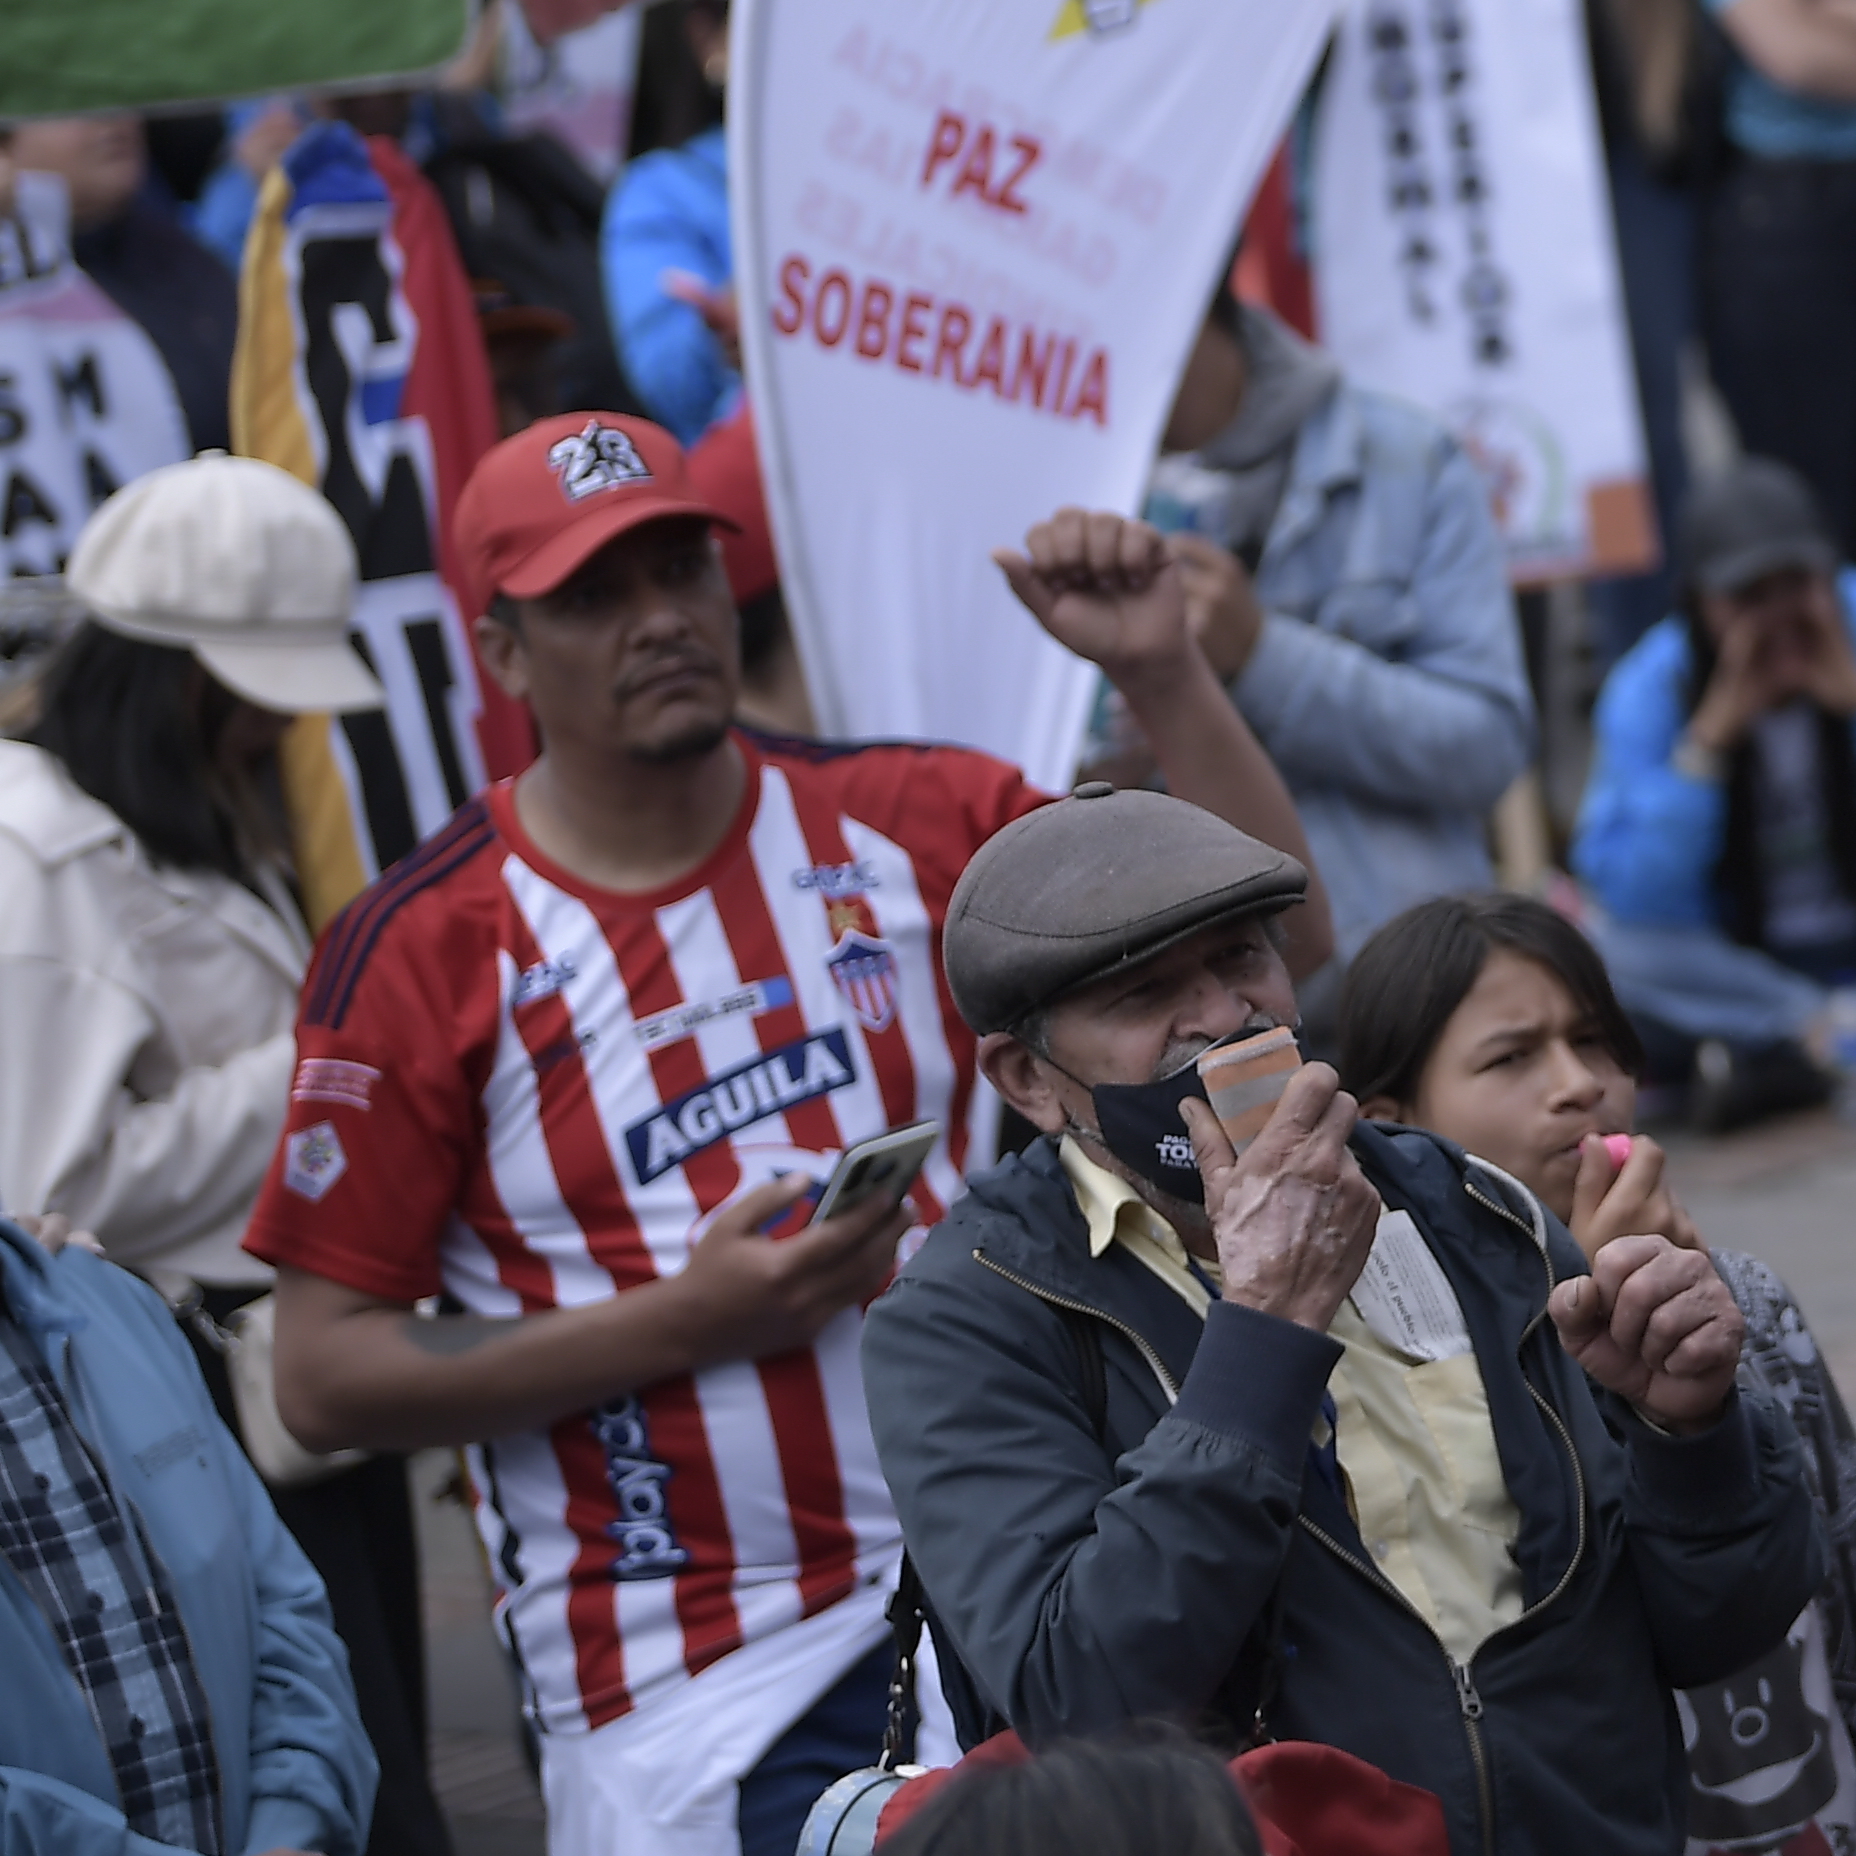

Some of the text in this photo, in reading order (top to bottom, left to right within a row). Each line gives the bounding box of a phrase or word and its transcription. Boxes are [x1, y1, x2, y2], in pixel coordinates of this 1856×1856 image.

[920, 107, 1045, 216] PAZ
[771, 251, 1109, 430] SOBERANIA
[643, 1038, 850, 1181] AGUILA
